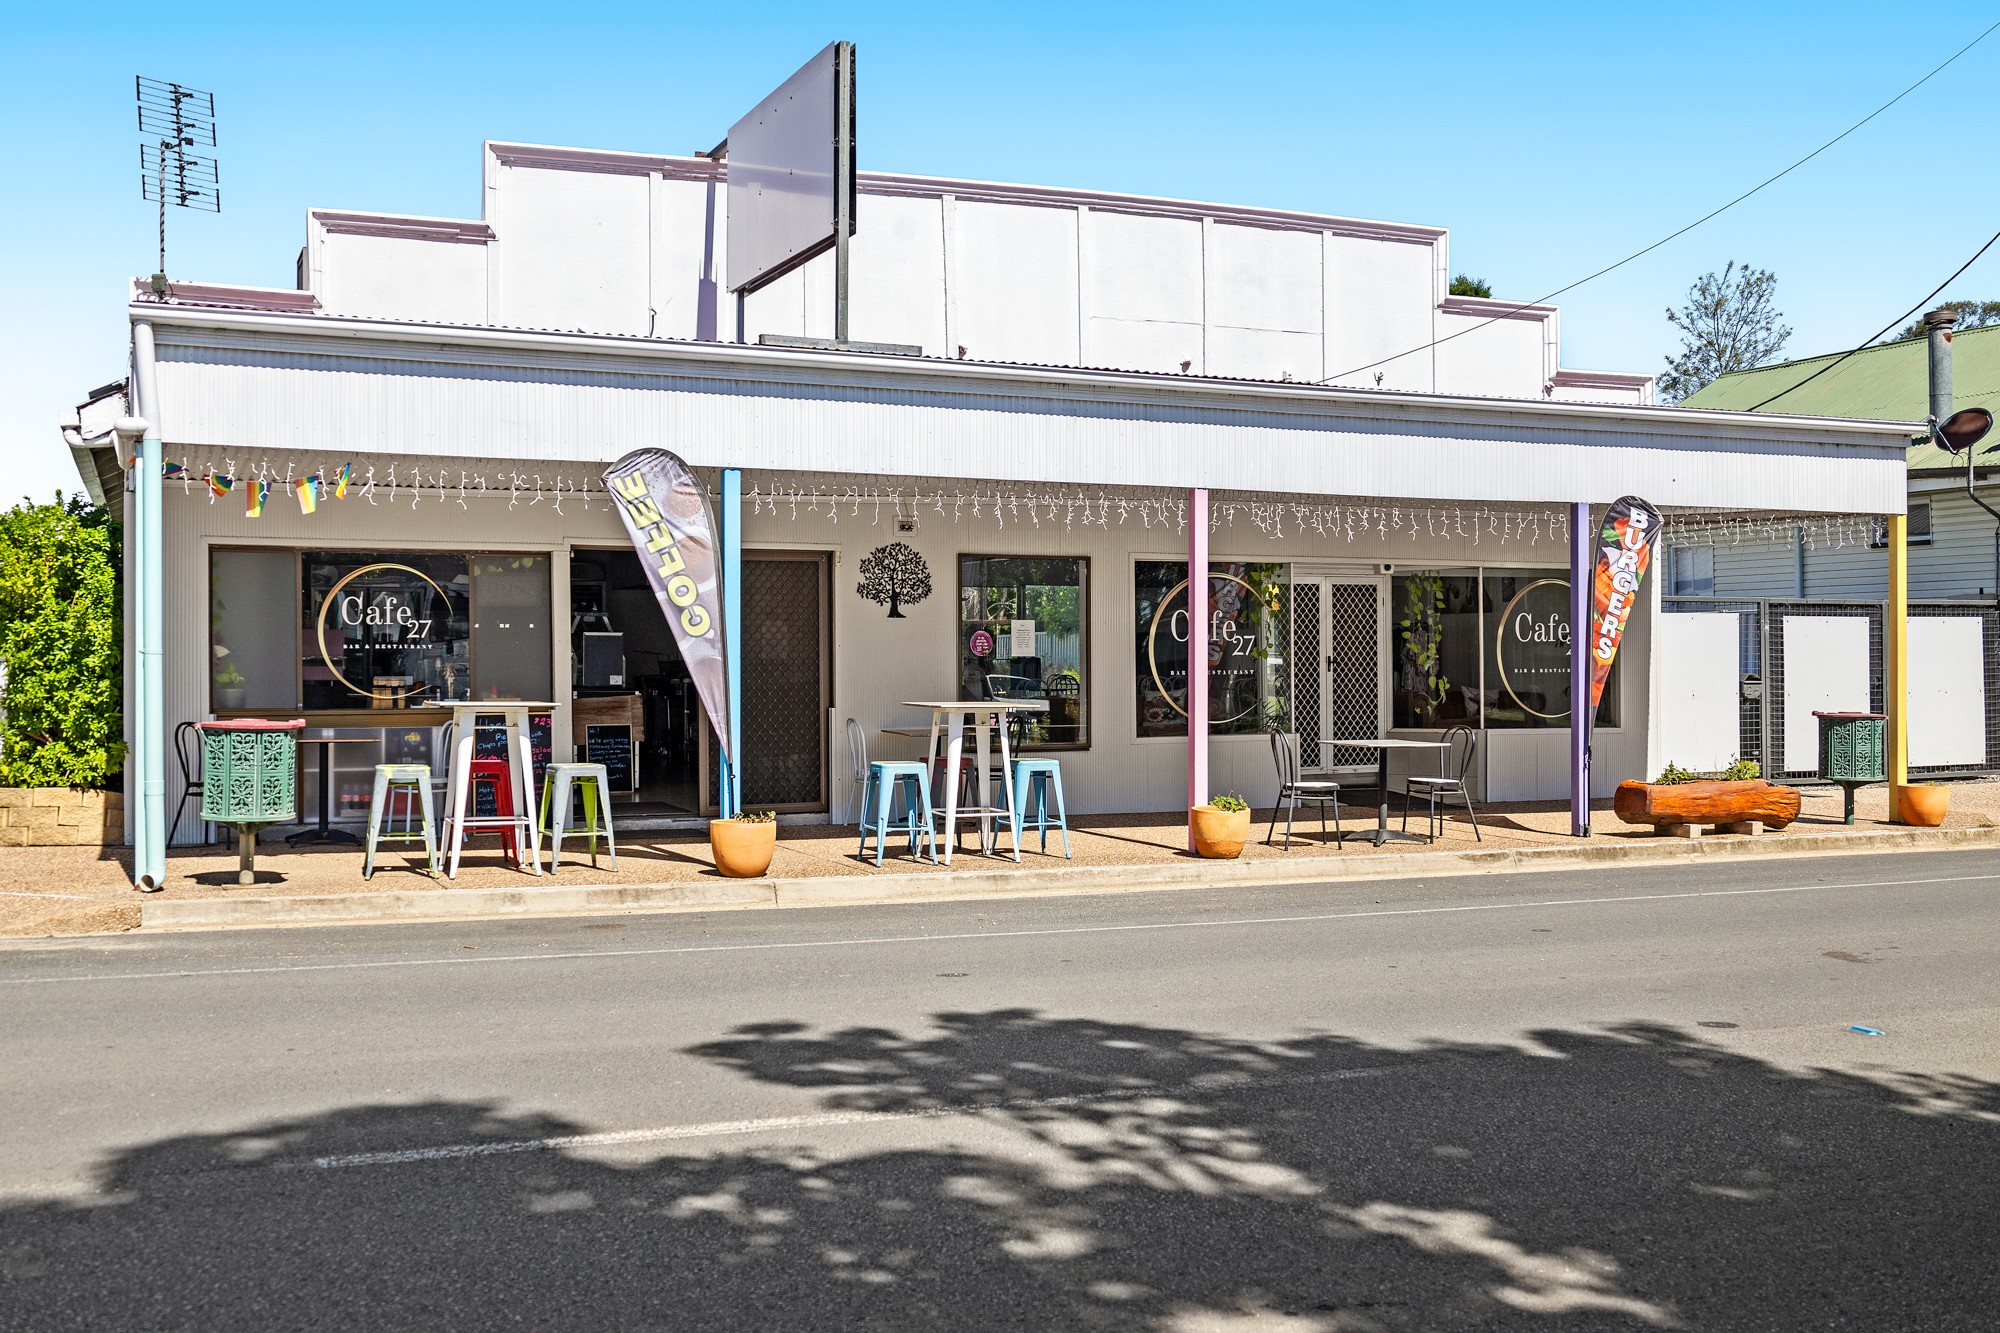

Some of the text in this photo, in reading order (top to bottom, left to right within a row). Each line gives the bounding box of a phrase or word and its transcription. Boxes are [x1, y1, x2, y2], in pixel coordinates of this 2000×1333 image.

[612, 470, 711, 637] COFFEE
[1596, 506, 1649, 660] BURGERS
[341, 596, 412, 626] Cafe
[1170, 609, 1237, 642] Cfe
[407, 619, 432, 639] 27
[1515, 612, 1570, 643] Cafe
[1232, 634, 1256, 656] 27
